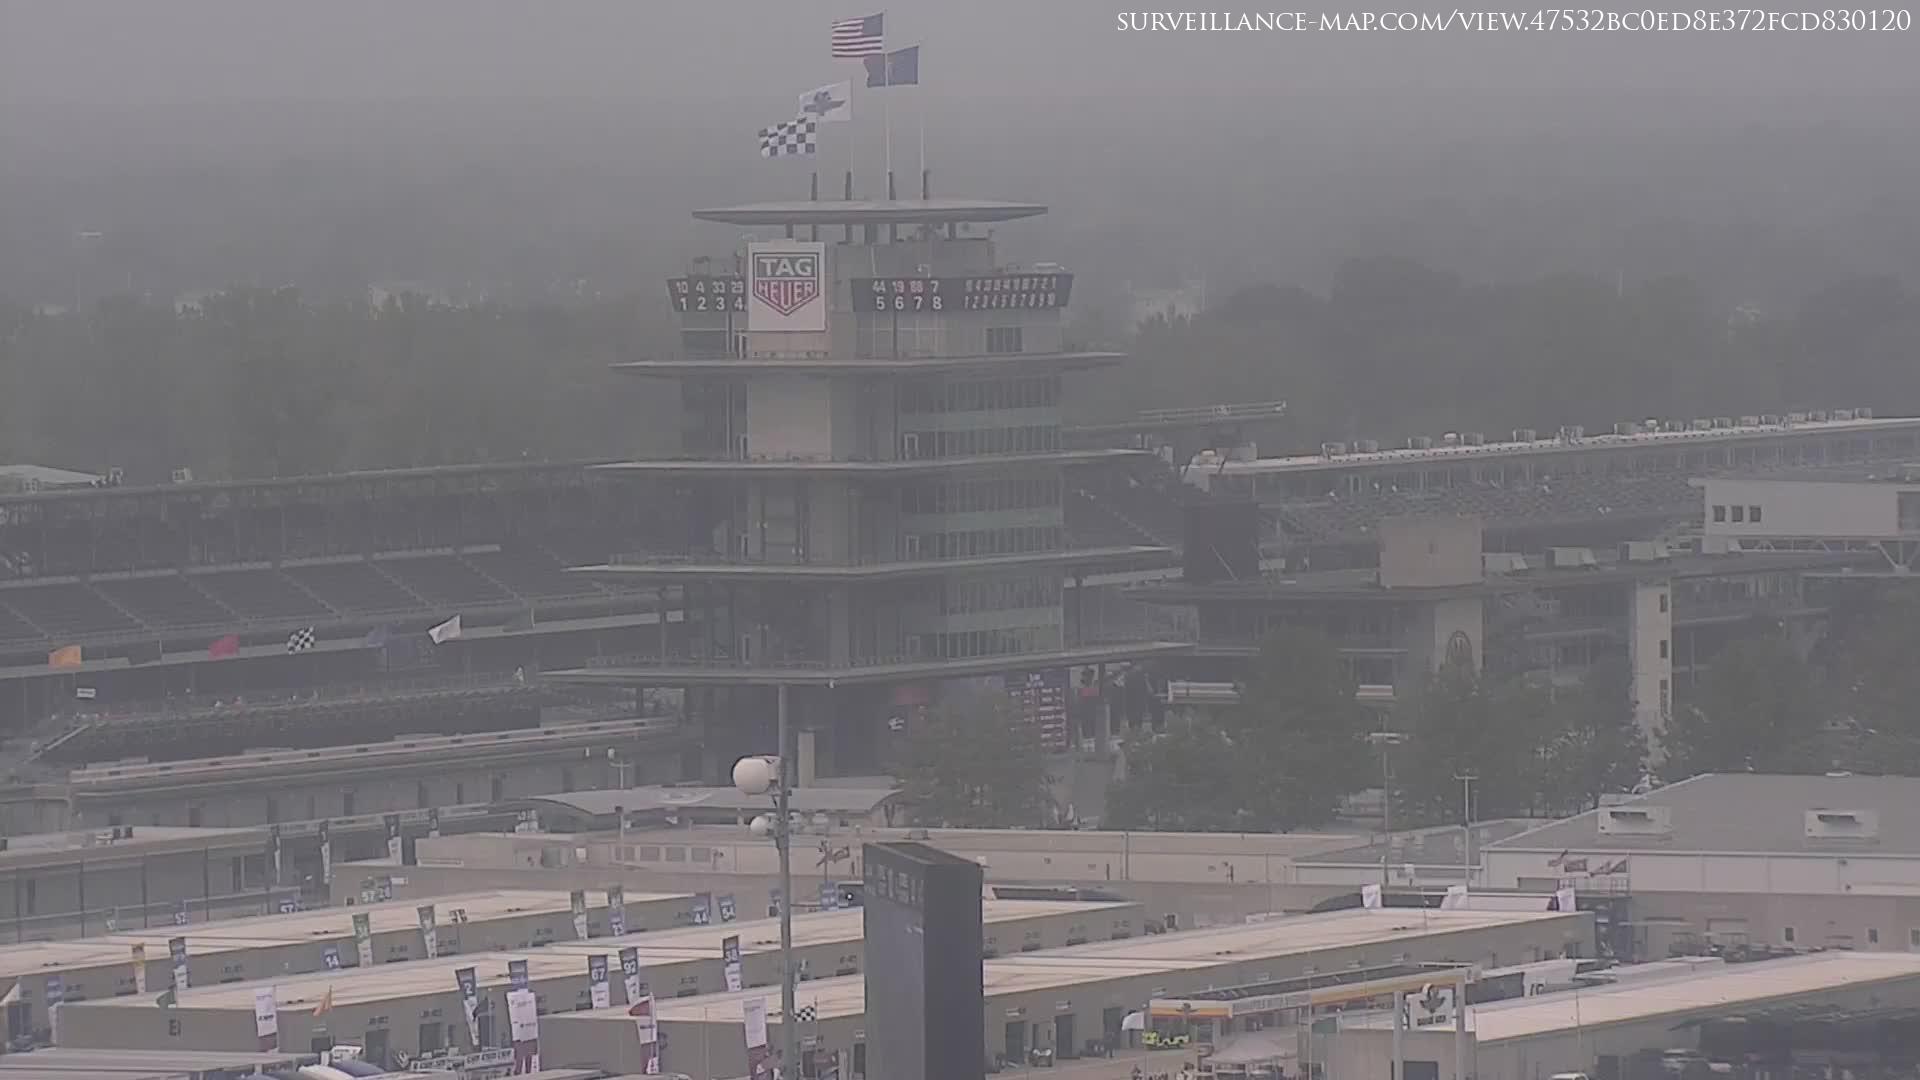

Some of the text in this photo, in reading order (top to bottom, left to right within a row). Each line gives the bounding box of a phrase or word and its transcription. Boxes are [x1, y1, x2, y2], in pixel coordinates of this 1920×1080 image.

[759, 258, 812, 276] TAG
[695, 281, 705, 293] 4
[930, 281, 939, 293] 7
[757, 279, 813, 309] HEUER
[680, 297, 744, 310] 1 2 3 4
[876, 297, 942, 310] 5 6 7 8
[325, 955, 339, 968] 14
[623, 961, 636, 974] 92
[591, 968, 605, 981] 67
[464, 983, 473, 995] 2
